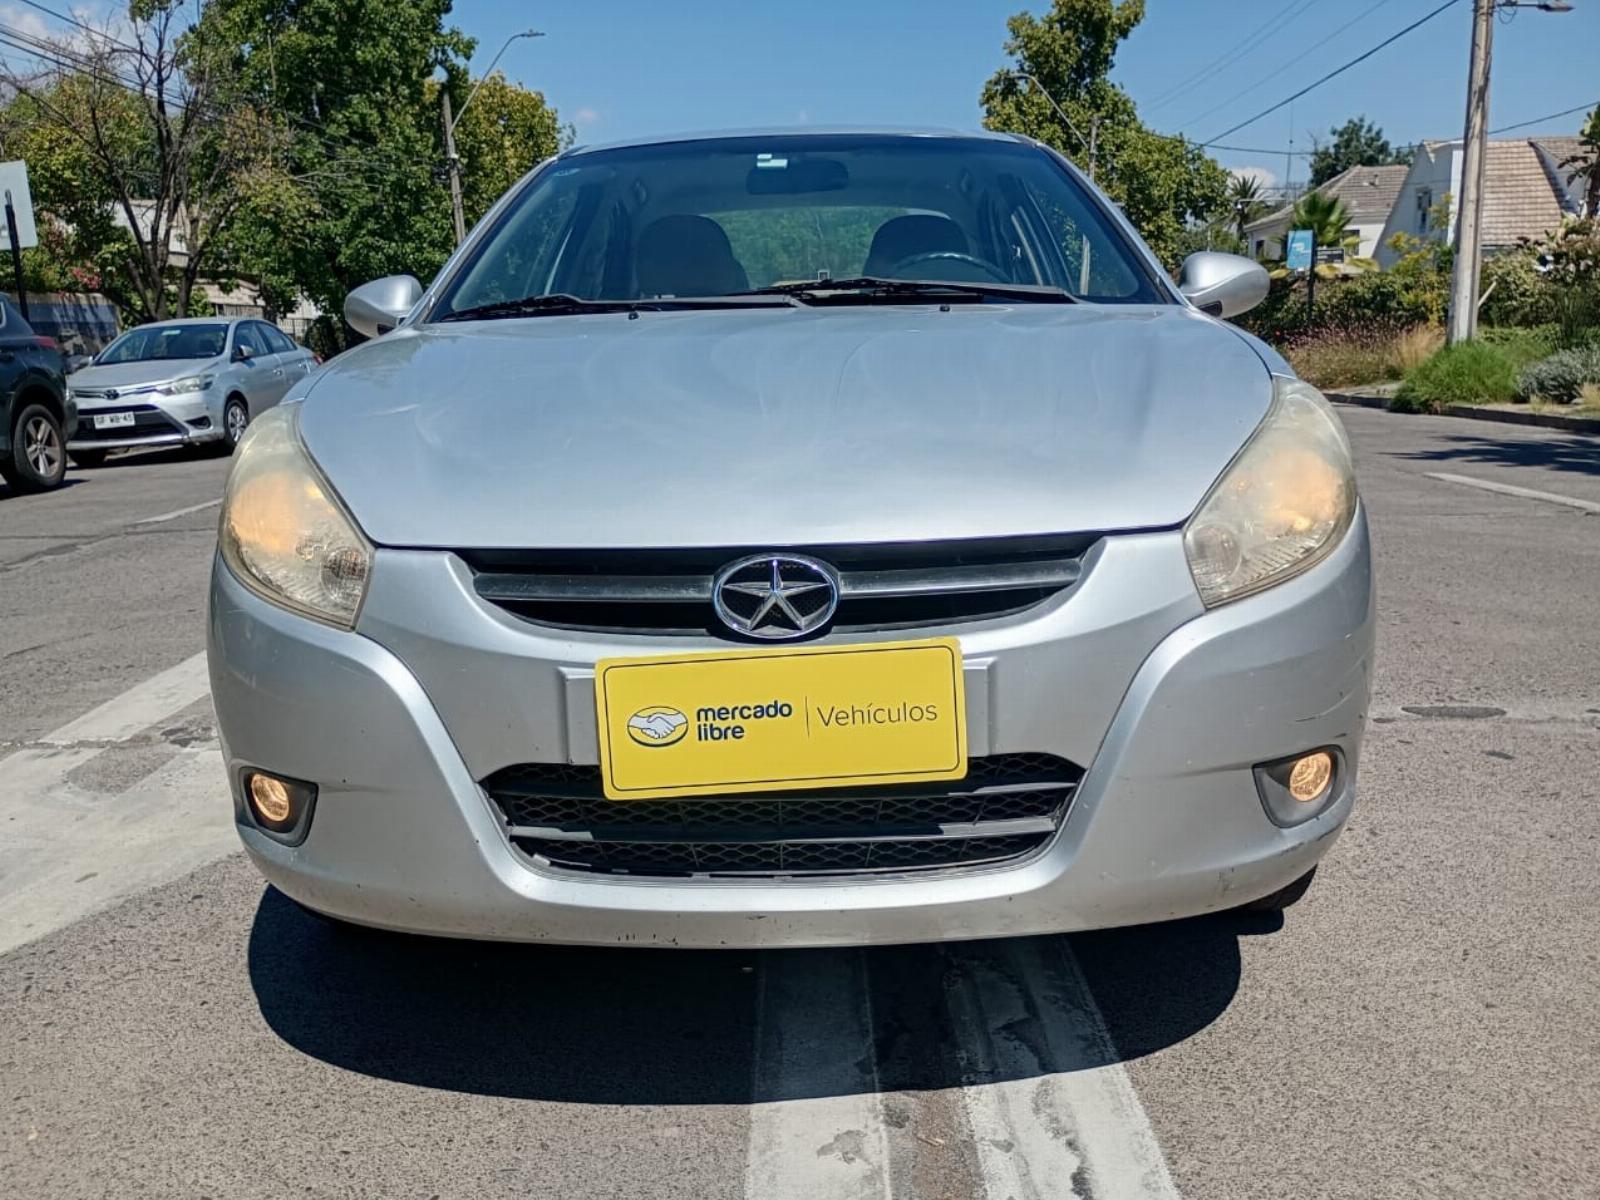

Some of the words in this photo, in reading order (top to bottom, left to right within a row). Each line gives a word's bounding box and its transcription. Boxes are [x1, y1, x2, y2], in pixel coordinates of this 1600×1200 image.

[697, 699, 793, 722] mercado
[816, 701, 938, 727] Vehículos
[697, 723, 745, 742] libre
